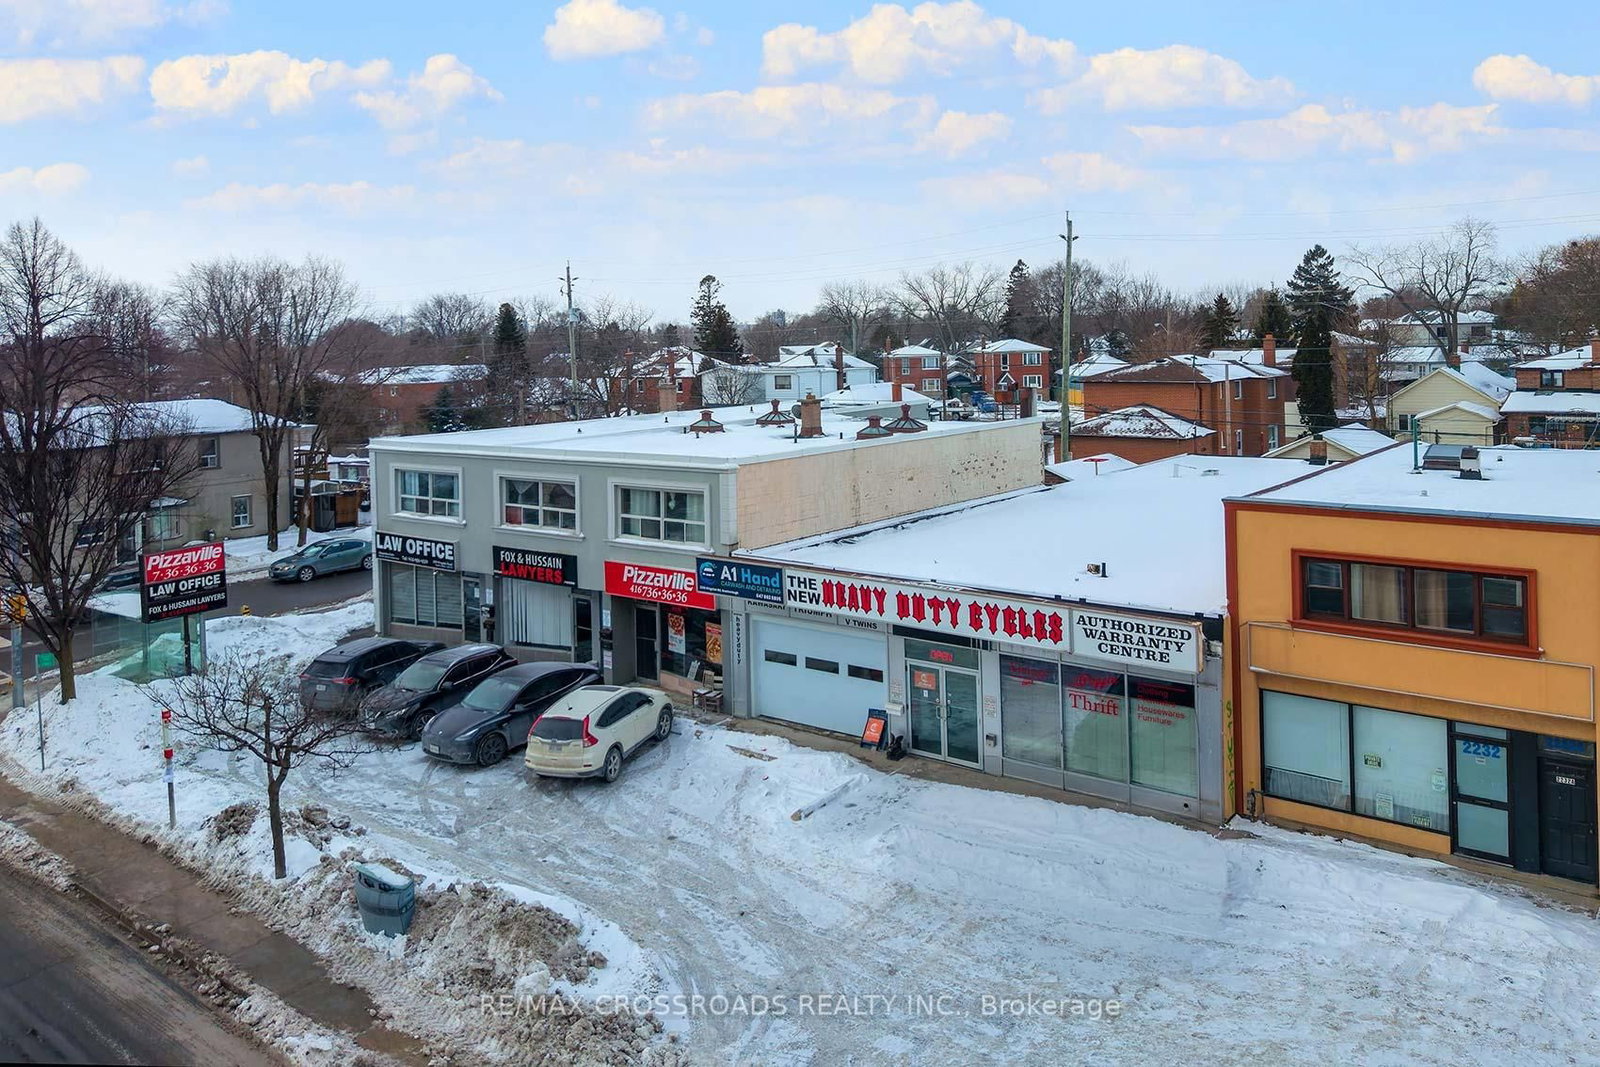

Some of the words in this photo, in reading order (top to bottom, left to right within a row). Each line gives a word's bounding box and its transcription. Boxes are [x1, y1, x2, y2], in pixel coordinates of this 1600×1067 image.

[147, 546, 222, 570] Pizzaville
[376, 534, 402, 552] LAW
[406, 539, 454, 560] OFFICE
[500, 550, 516, 563] FOX
[516, 553, 524, 564] &
[525, 554, 562, 569] HUSSAIN
[501, 562, 563, 584] LAWYERS
[623, 566, 695, 592] Pizzaville
[721, 565, 737, 582] A1
[741, 568, 779, 588] Hand
[787, 575, 817, 590] THE
[150, 582, 175, 597] LAW
[179, 574, 221, 591] OFFICE
[788, 589, 821, 605] NEW
[148, 605, 162, 615] FOX
[169, 599, 196, 610] HUSSAIN
[198, 592, 225, 604] LAWYERS
[822, 578, 887, 617] HEAVY
[896, 590, 961, 629] DUTY
[968, 600, 1063, 645] CYCLES
[853, 620, 878, 629] TWINS
[1076, 615, 1192, 640] AUTHORIZED
[1083, 628, 1185, 652] WARRANTY
[1098, 643, 1170, 663] CENTRE
[1069, 693, 1118, 716] Thrift
[1138, 704, 1185, 719] Housewares
[1462, 740, 1501, 759] 2232
